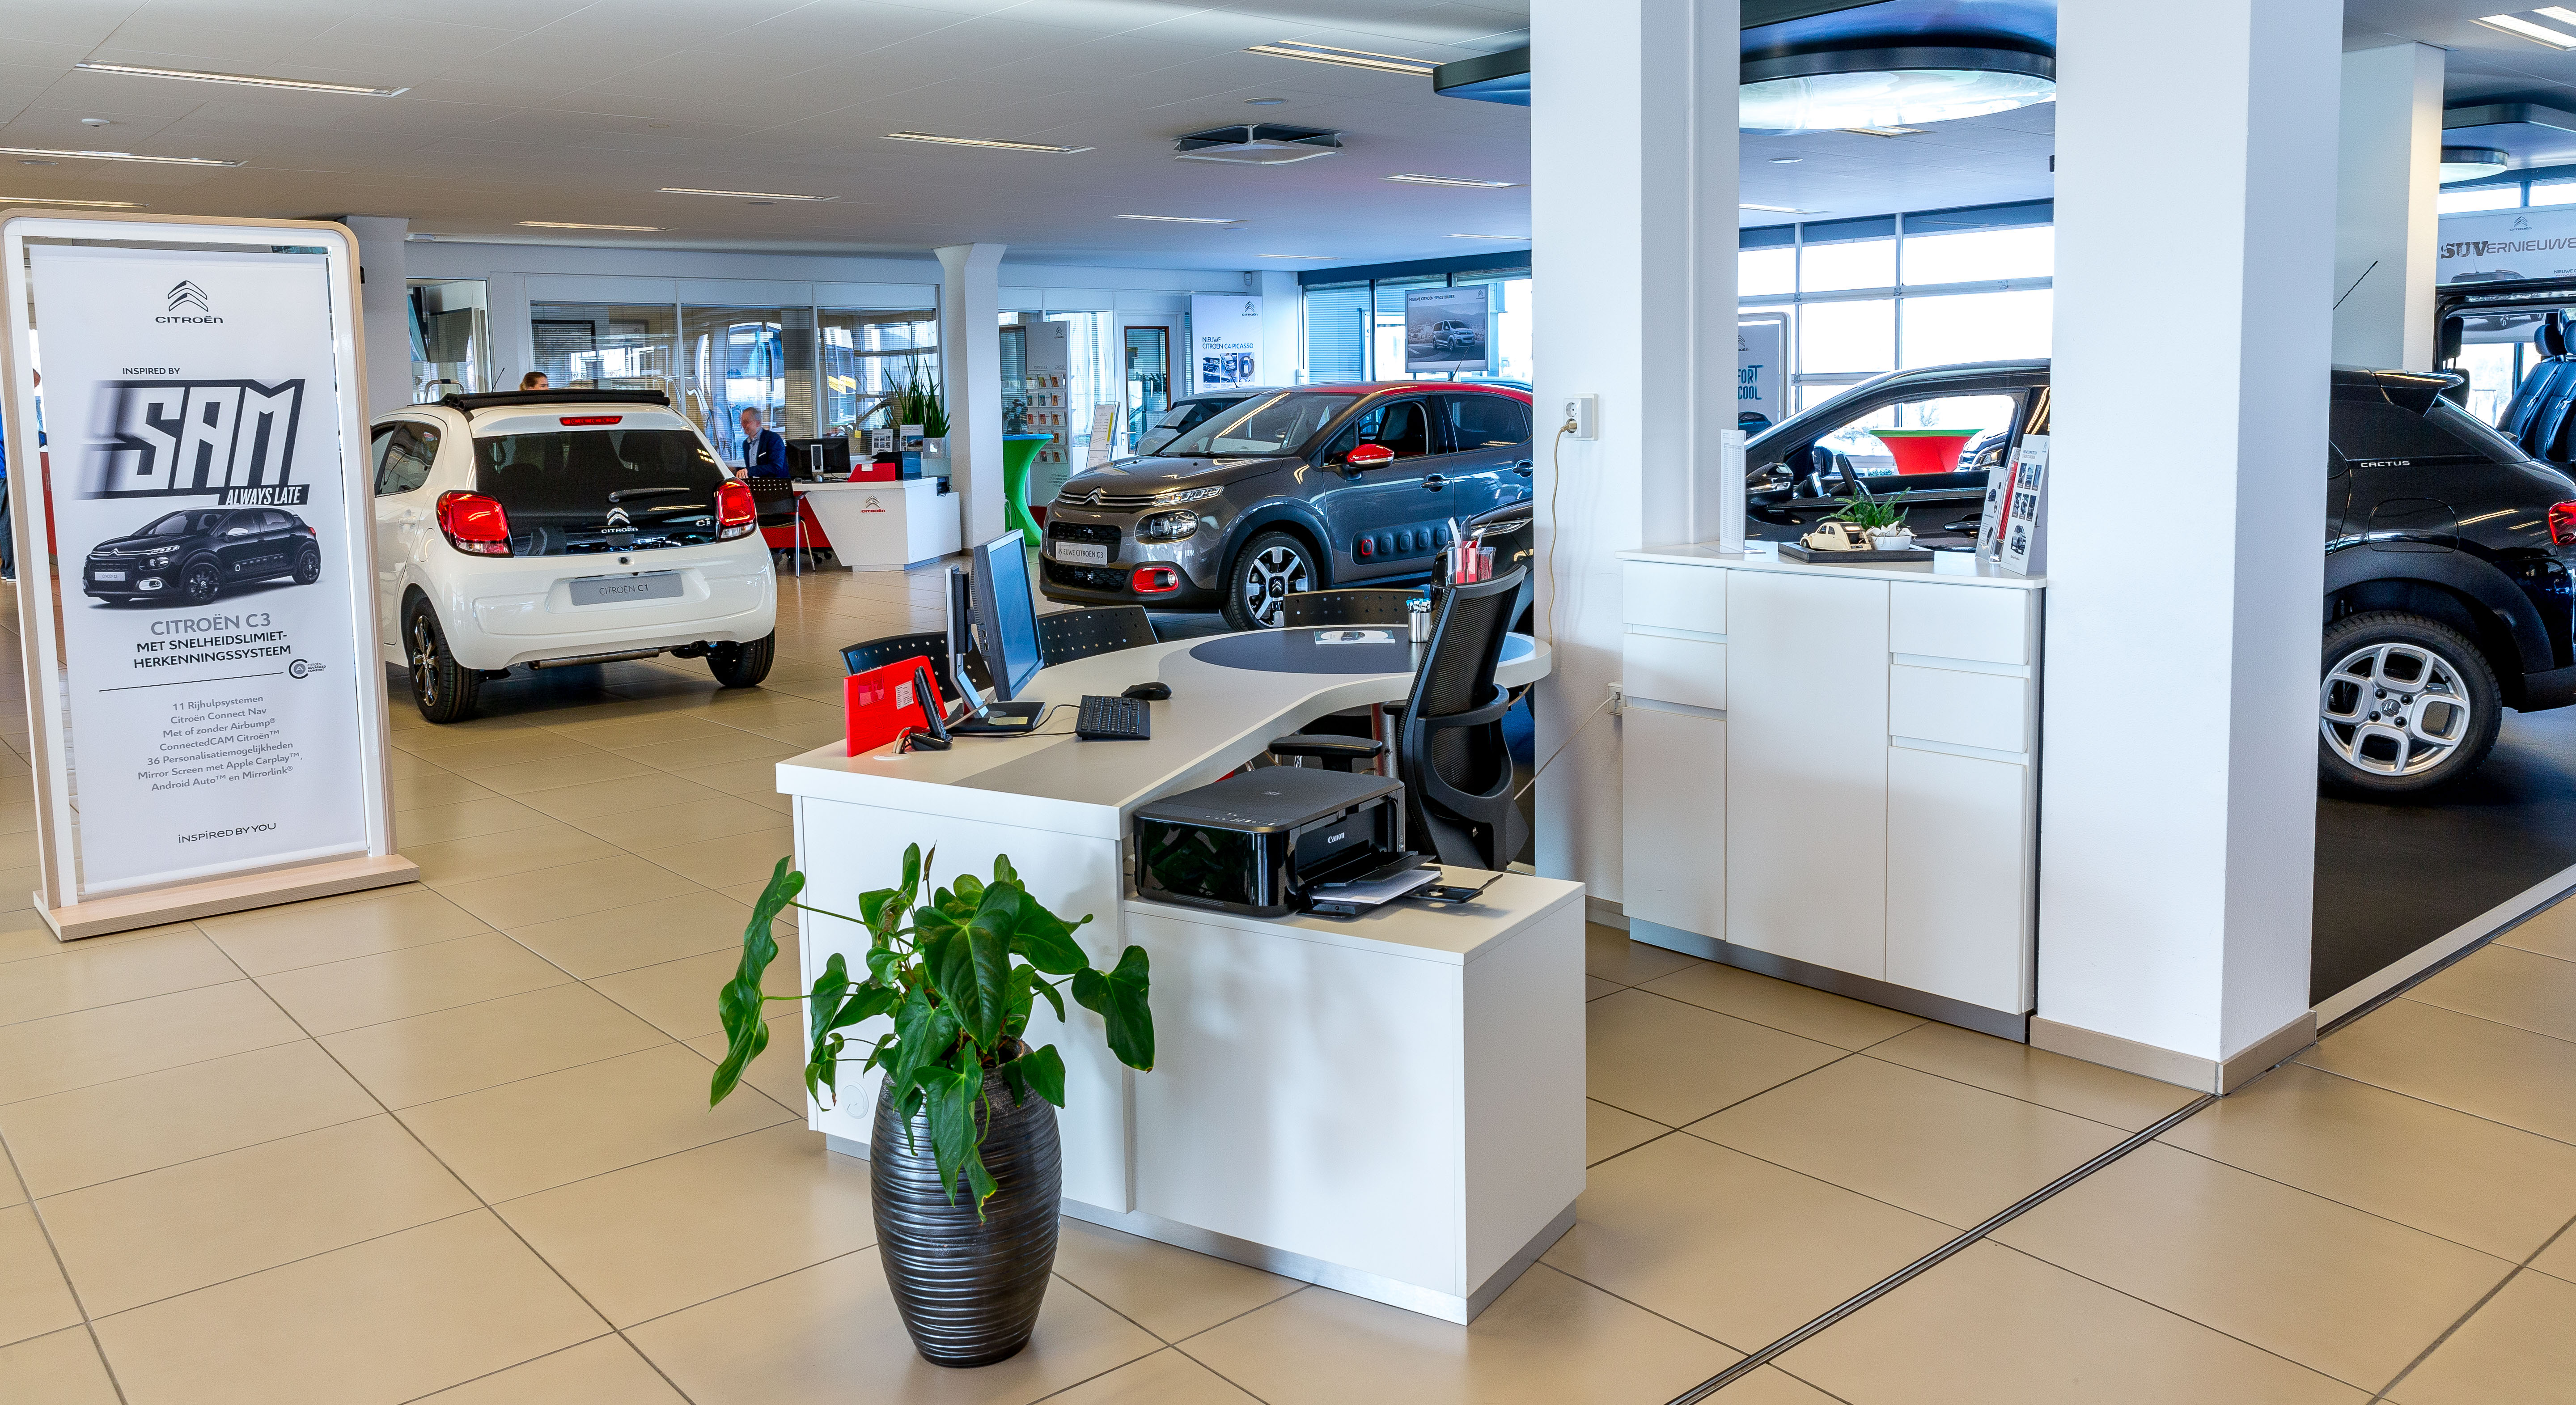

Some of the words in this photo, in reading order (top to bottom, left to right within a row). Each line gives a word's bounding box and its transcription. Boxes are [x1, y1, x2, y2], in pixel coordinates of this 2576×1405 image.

[155, 315, 223, 323] CITROËN
[1738, 386, 1762, 399] COOL
[101, 379, 305, 492] SAM
[225, 487, 272, 505] ALWAYS
[274, 487, 302, 505] LATE
[696, 518, 710, 526] C1
[1076, 549, 1096, 557] CITROËN
[599, 584, 635, 595] CITROËN
[151, 614, 240, 636] CITROËN
[246, 613, 271, 628] C3
[137, 641, 165, 653] MET
[169, 631, 287, 650] SNELHEIDSLIMIET-
[134, 645, 291, 669] HERKENNINGSSYSTEEM
[173, 703, 184, 711] 11
[188, 696, 263, 710] Rijhulpsystemen
[171, 715, 205, 724] Citroën
[208, 710, 246, 720] Connect
[248, 708, 267, 716] Nav
[185, 727, 195, 735] of
[196, 724, 228, 734] zonder
[160, 735, 234, 751] ConnectedCAM
[148, 757, 160, 765] 36
[163, 741, 293, 764] Personalisatiemogelijkheden
[138, 771, 169, 780] Mirror
[172, 767, 203, 775] Screen
[226, 759, 253, 770] Apple
[152, 779, 190, 791] Android
[235, 827, 250, 835] BY
[251, 823, 276, 832] YOU
[1327, 832, 1345, 844] Canon
